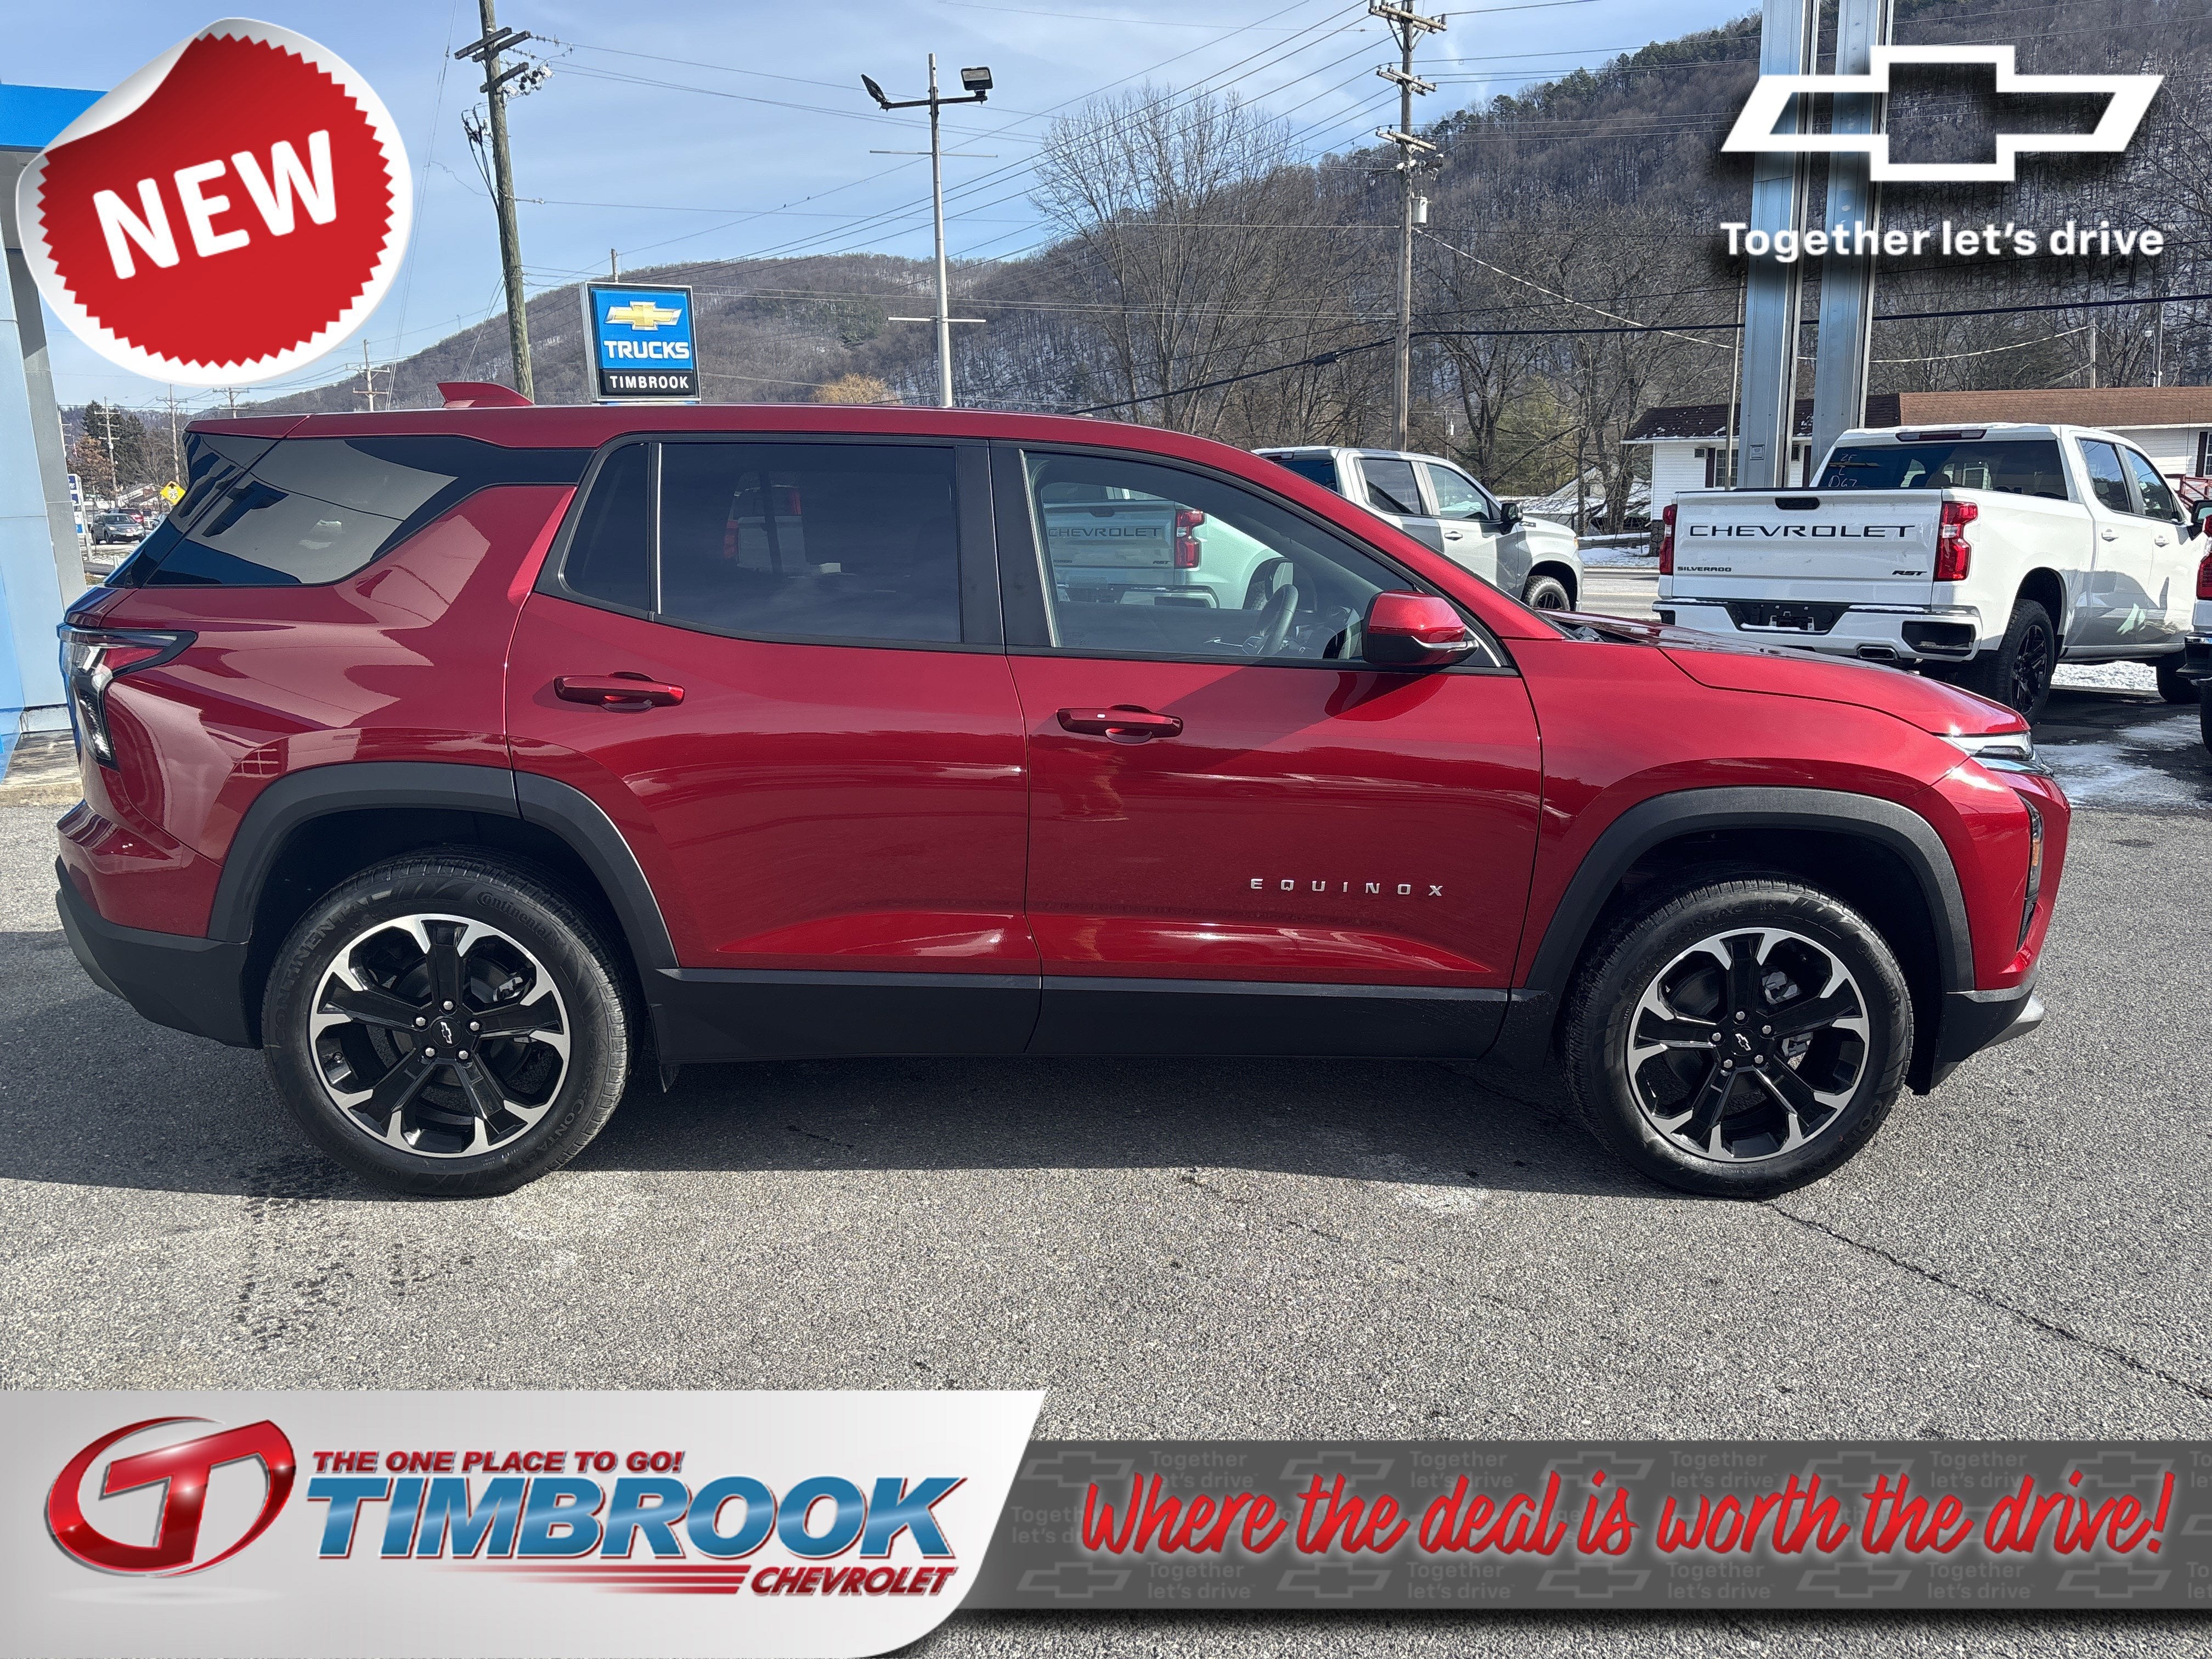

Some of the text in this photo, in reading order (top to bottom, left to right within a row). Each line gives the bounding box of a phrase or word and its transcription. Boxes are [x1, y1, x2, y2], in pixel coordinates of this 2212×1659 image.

[603, 341, 690, 359] TRUCKS
[610, 376, 689, 388] TIMBROOK
[1048, 528, 1161, 537] CHEVROLET
[1690, 525, 1915, 538] CHEVROLET
[1250, 878, 1443, 897] EQUINOX
